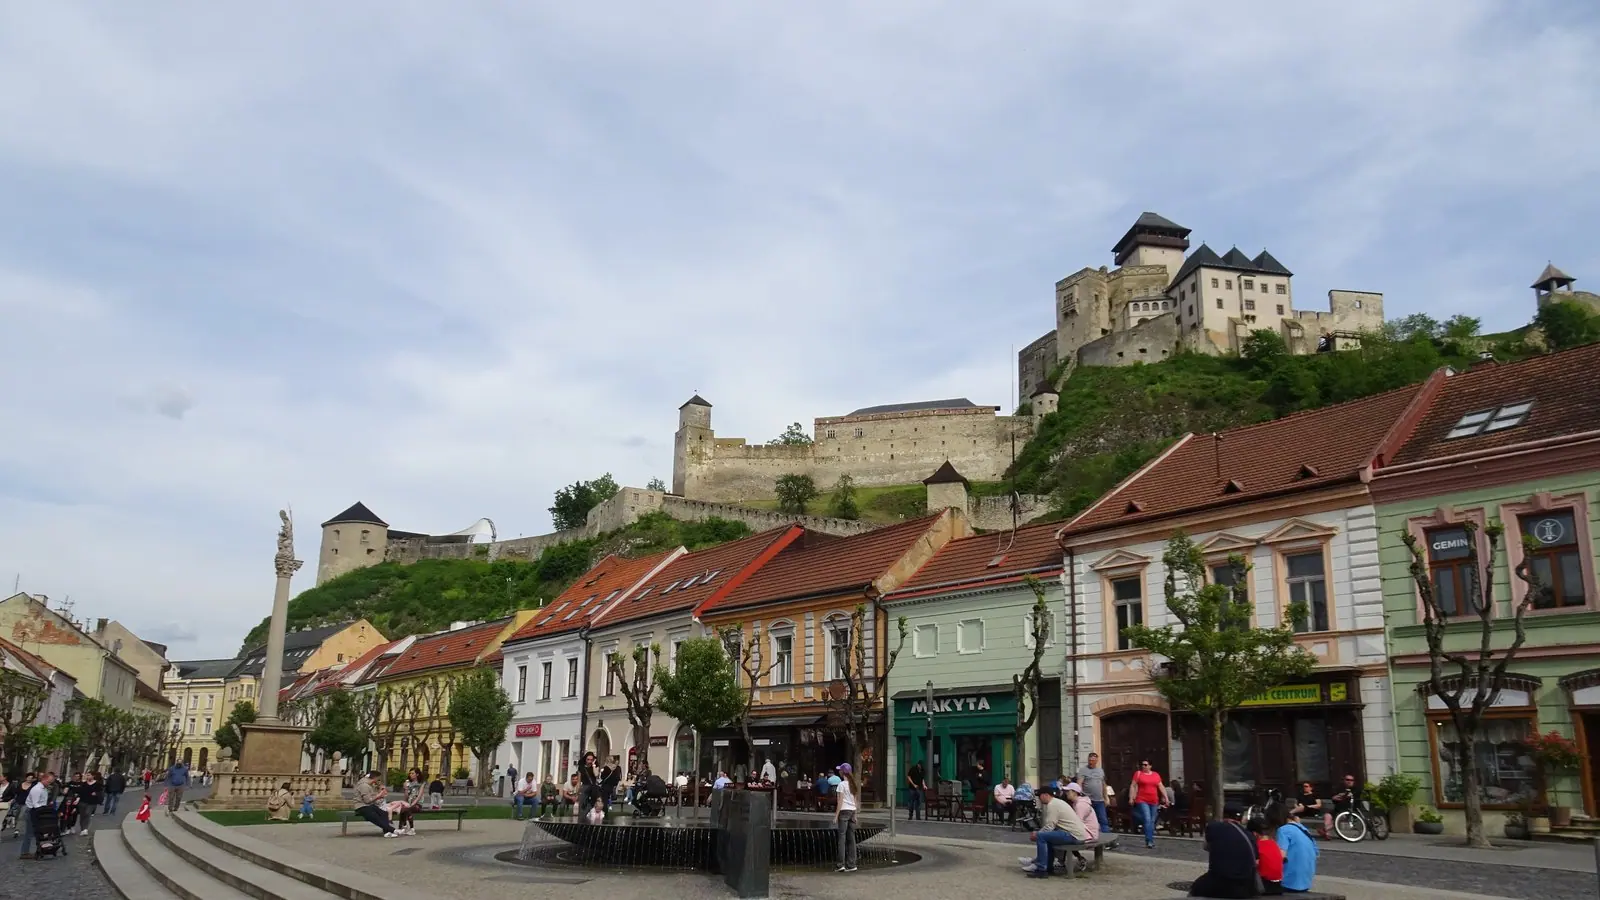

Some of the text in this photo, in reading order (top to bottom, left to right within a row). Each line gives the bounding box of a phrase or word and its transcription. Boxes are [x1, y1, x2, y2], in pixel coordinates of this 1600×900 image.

[1433, 538, 1468, 550] GEMIN
[1271, 688, 1317, 701] CENTRUM
[910, 697, 990, 714] MAKYTA
